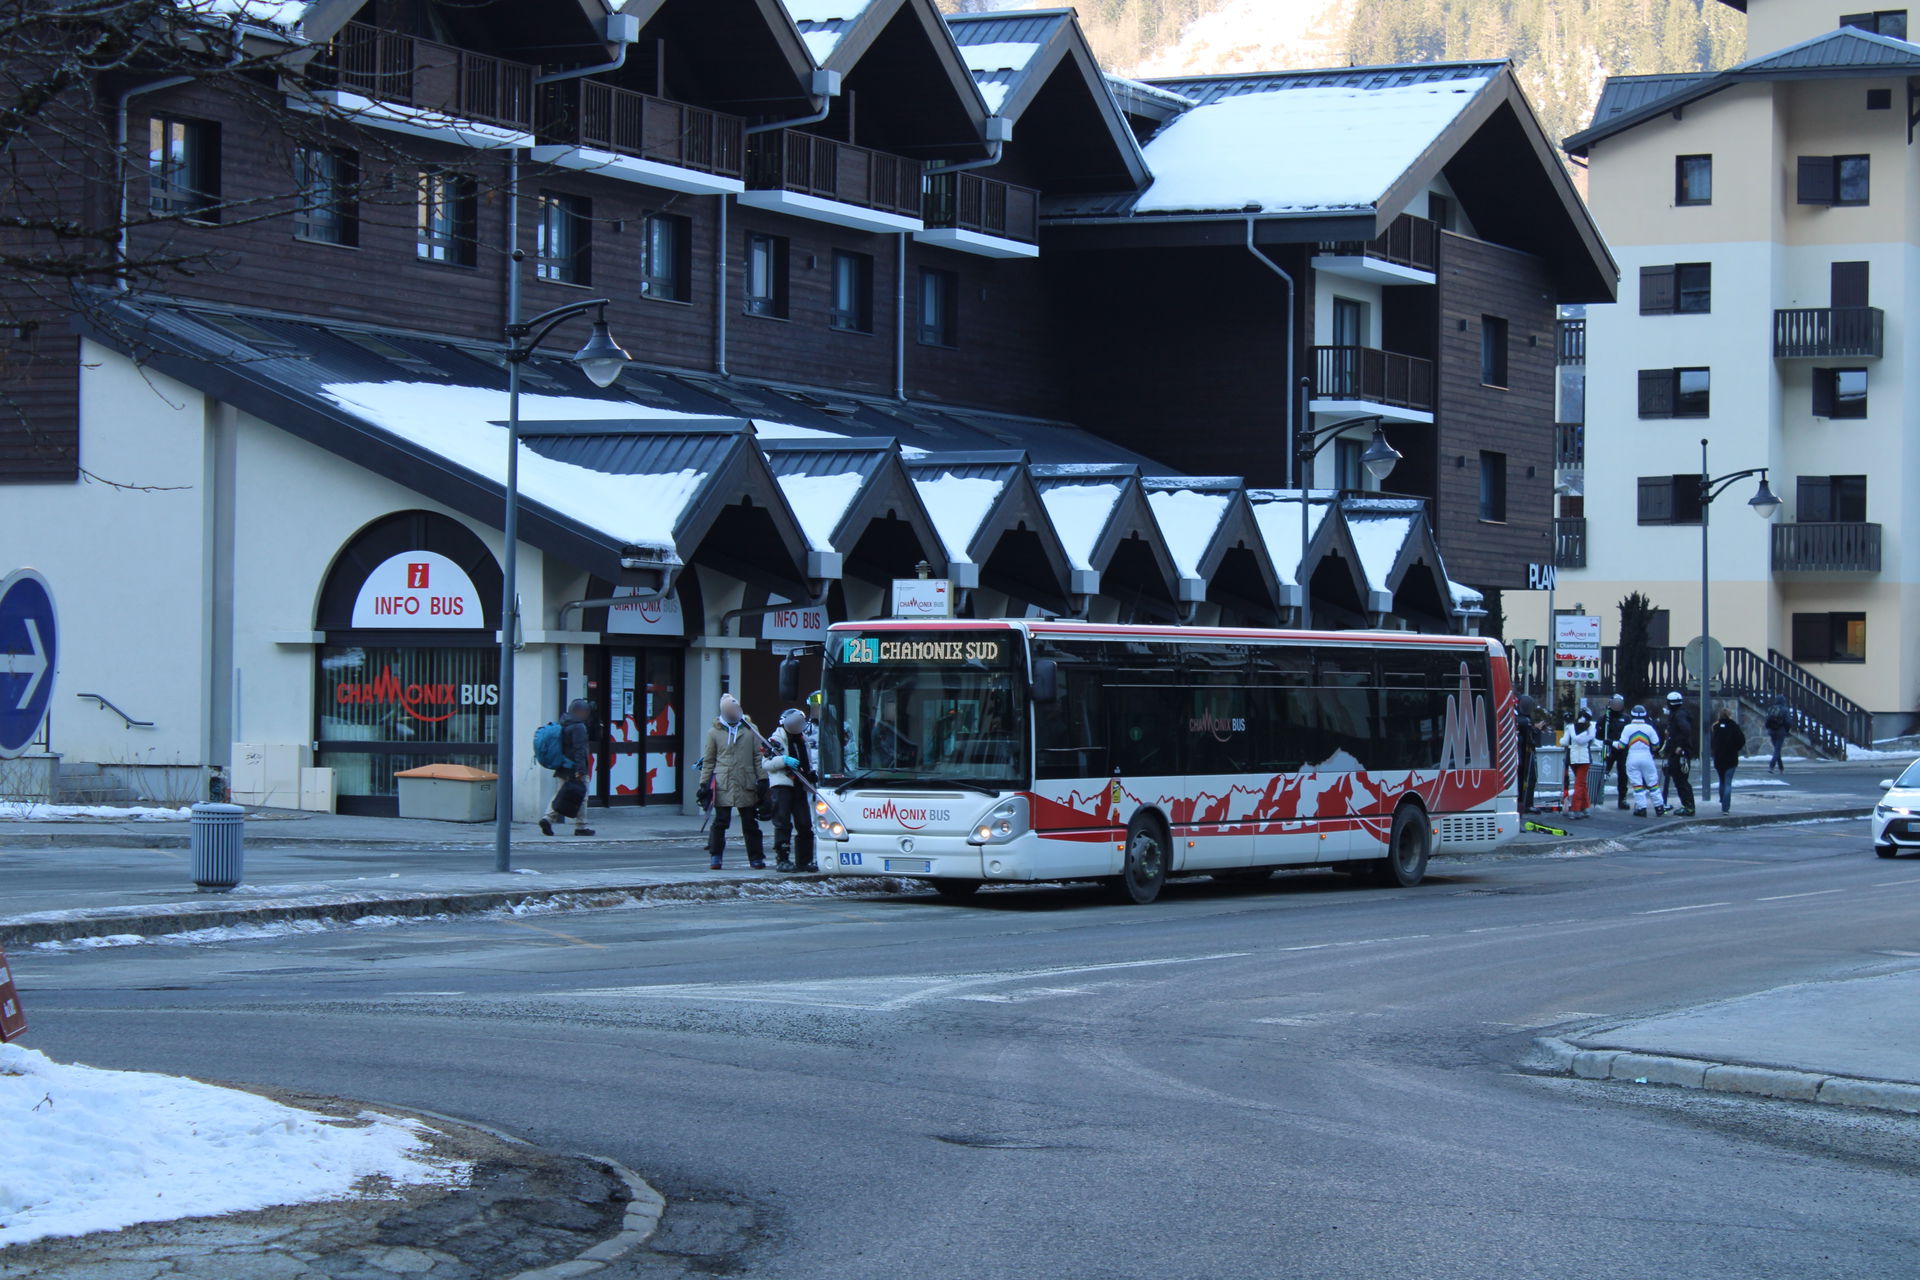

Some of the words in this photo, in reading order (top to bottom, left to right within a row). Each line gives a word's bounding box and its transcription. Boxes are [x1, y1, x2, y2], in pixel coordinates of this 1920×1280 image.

[1529, 563, 1557, 590] PLAN
[375, 596, 420, 615] INFO
[430, 596, 464, 615] BUS
[773, 610, 799, 629] INFO
[803, 611, 821, 630] BUS
[849, 639, 873, 663] 2b
[880, 641, 963, 660] CHAMONIX
[965, 641, 999, 660] SUD
[336, 665, 458, 722] CHAMONIX
[461, 684, 498, 705] BUS
[1189, 706, 1232, 742] CHAMONIX
[1232, 718, 1246, 732] BUS
[863, 798, 928, 830] CHAMONIX
[929, 809, 951, 821] BUS
